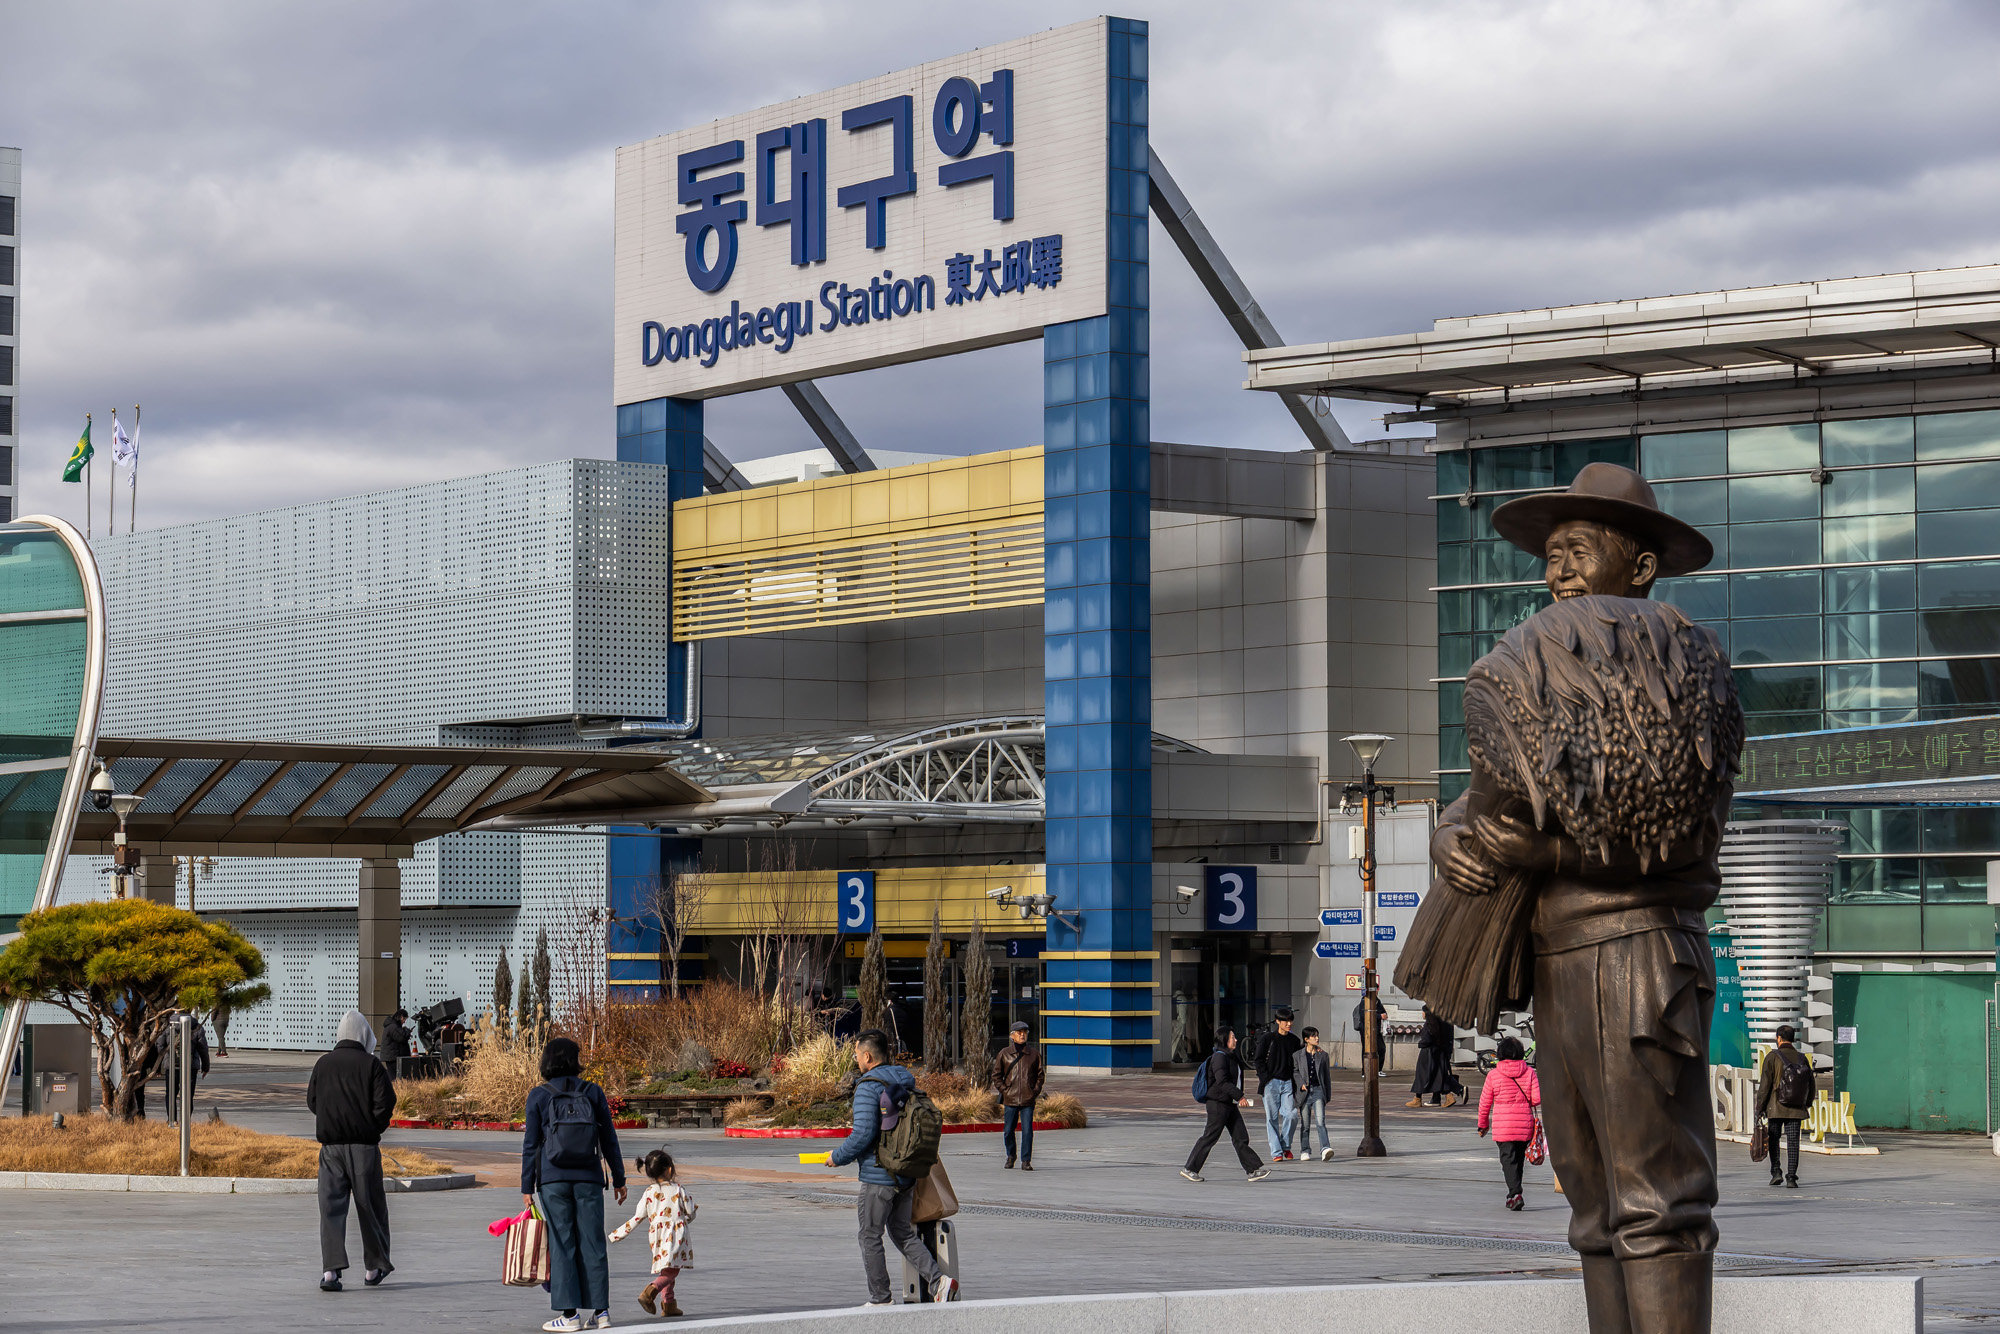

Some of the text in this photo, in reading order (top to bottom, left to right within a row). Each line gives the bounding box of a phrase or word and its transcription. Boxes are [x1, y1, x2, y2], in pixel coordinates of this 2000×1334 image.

[675, 69, 1014, 294] 동대구역
[945, 234, 1063, 307] 東大邱驛
[642, 270, 935, 368] Dongdaegu Station
[1795, 739, 1916, 777] 도심순환코스
[1924, 732, 1972, 770] (매주
[845, 877, 866, 928] 3
[1218, 872, 1245, 925] 3
[1012, 941, 1018, 956] 3
